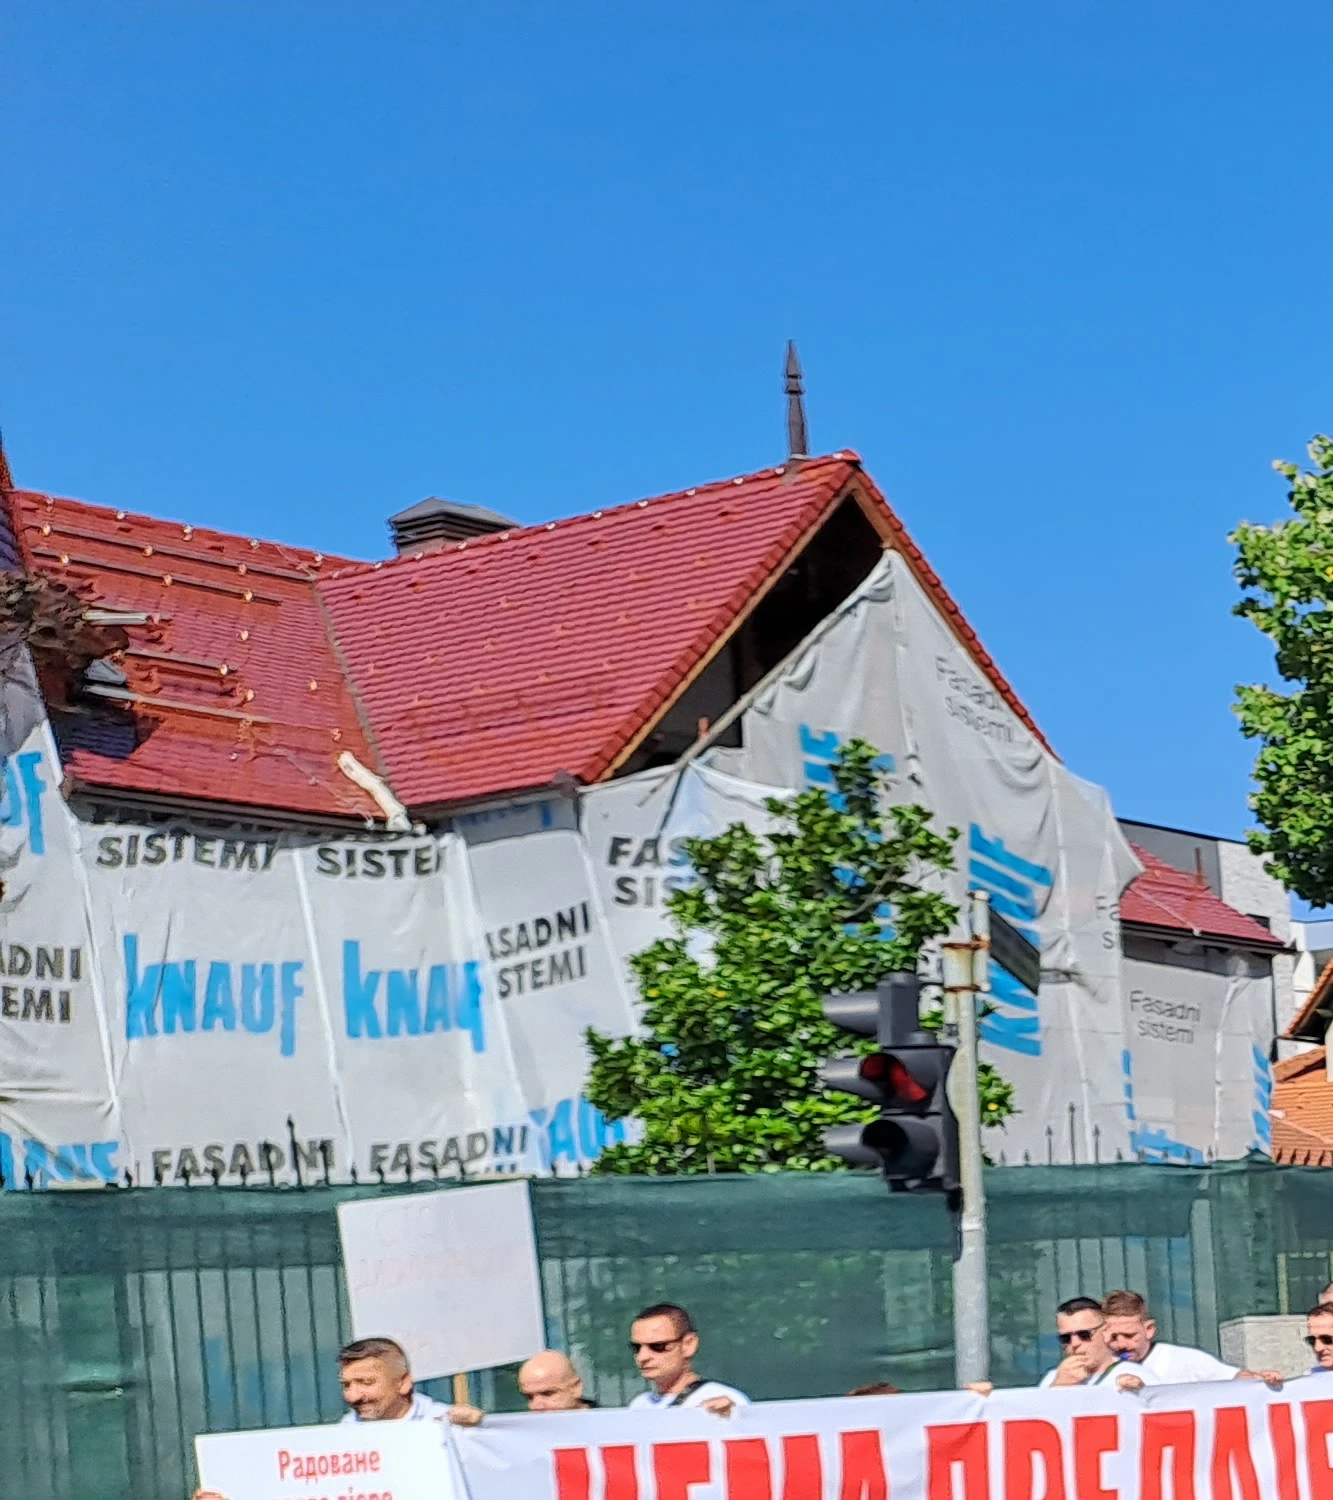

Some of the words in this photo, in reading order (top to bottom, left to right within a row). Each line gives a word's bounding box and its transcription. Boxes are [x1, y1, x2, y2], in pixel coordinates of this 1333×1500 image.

[1129, 990, 1201, 1023] Fasadni
[1137, 1018, 1194, 1044] sistemi
[369, 1124, 531, 1173] FASADNI
[278, 1449, 382, 1482] Радоване
